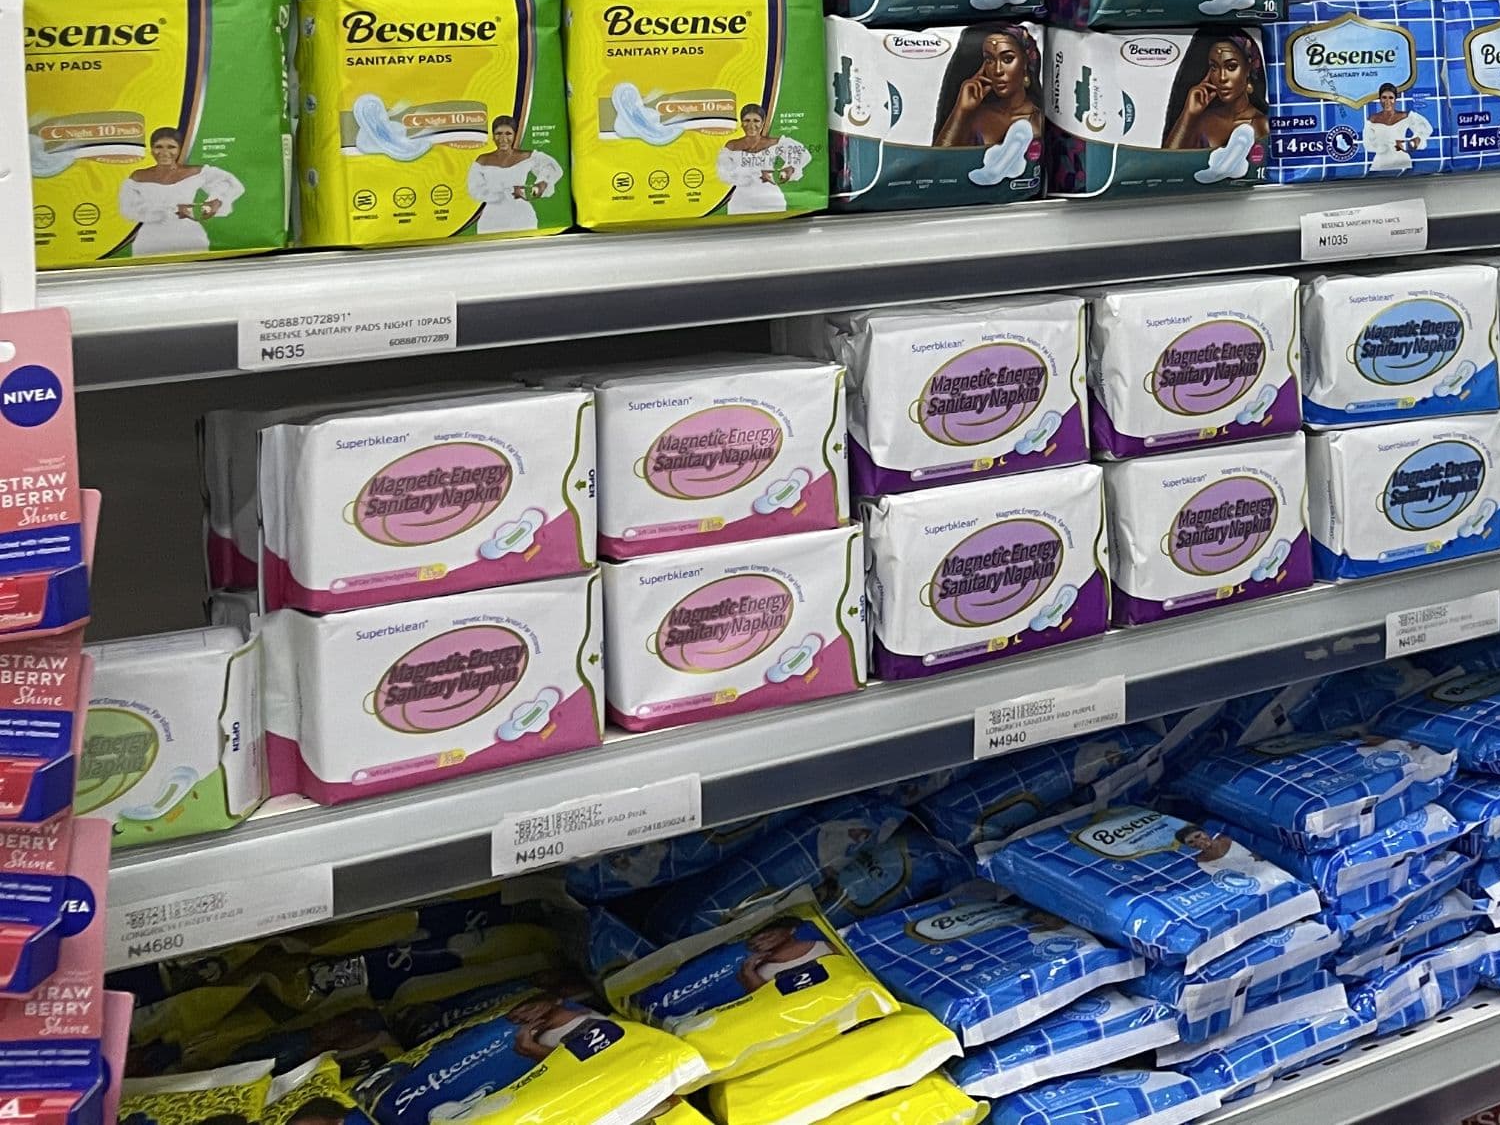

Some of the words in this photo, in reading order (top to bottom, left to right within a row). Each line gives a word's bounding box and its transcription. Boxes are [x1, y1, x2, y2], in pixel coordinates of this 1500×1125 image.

[343, 10, 503, 44] Besense
[602, 5, 752, 40] Besense
[345, 54, 413, 66] SANITARY
[417, 53, 453, 64] PADS
[1307, 44, 1399, 66] Besense
[1271, 117, 1289, 127] Star
[1292, 116, 1316, 127] Pack
[1459, 115, 1473, 123] Star
[1475, 113, 1489, 123] Pack
[260, 330, 301, 341] BESENSE
[305, 326, 352, 336] SANITARY
[355, 323, 380, 333] PADS
[384, 320, 413, 330] NIGHT
[417, 316, 452, 326] 10PADS
[930, 369, 996, 393] Magnetic
[997, 365, 1047, 386] Energy
[3, 388, 56, 404] NIVEA
[927, 386, 992, 416] Sanitary
[990, 386, 1040, 408] Napkin
[369, 468, 449, 497] Magnetic
[450, 464, 511, 486] Energy
[2, 487, 67, 508] BERRY
[364, 493, 441, 518] Sanitary
[439, 485, 500, 511] Napkin
[18, 507, 69, 527] Shine
